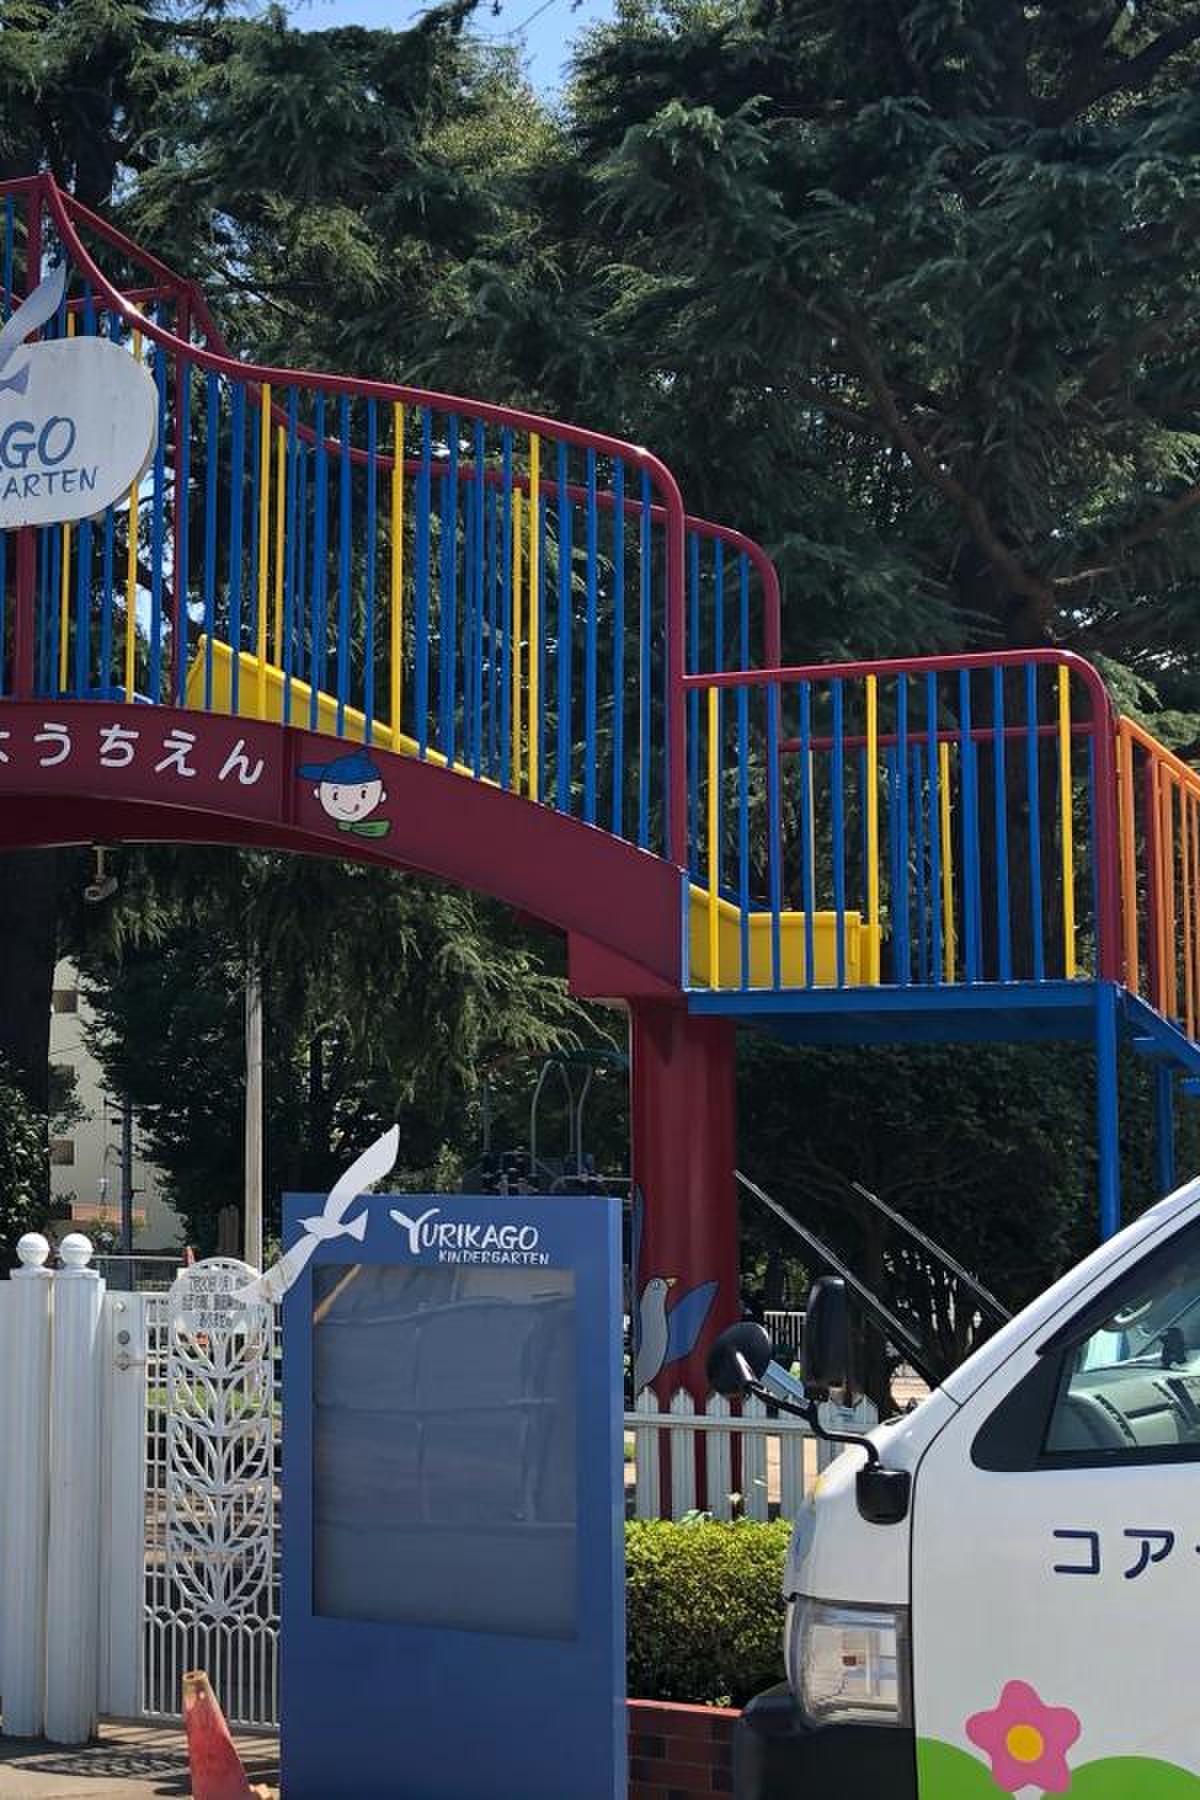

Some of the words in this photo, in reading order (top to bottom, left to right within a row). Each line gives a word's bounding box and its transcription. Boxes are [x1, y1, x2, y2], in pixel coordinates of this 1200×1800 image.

[389, 1208, 538, 1254] YURIKAGO
[438, 1250, 550, 1265] KINDERGARTEN
[1052, 1529, 1200, 1580] コア
